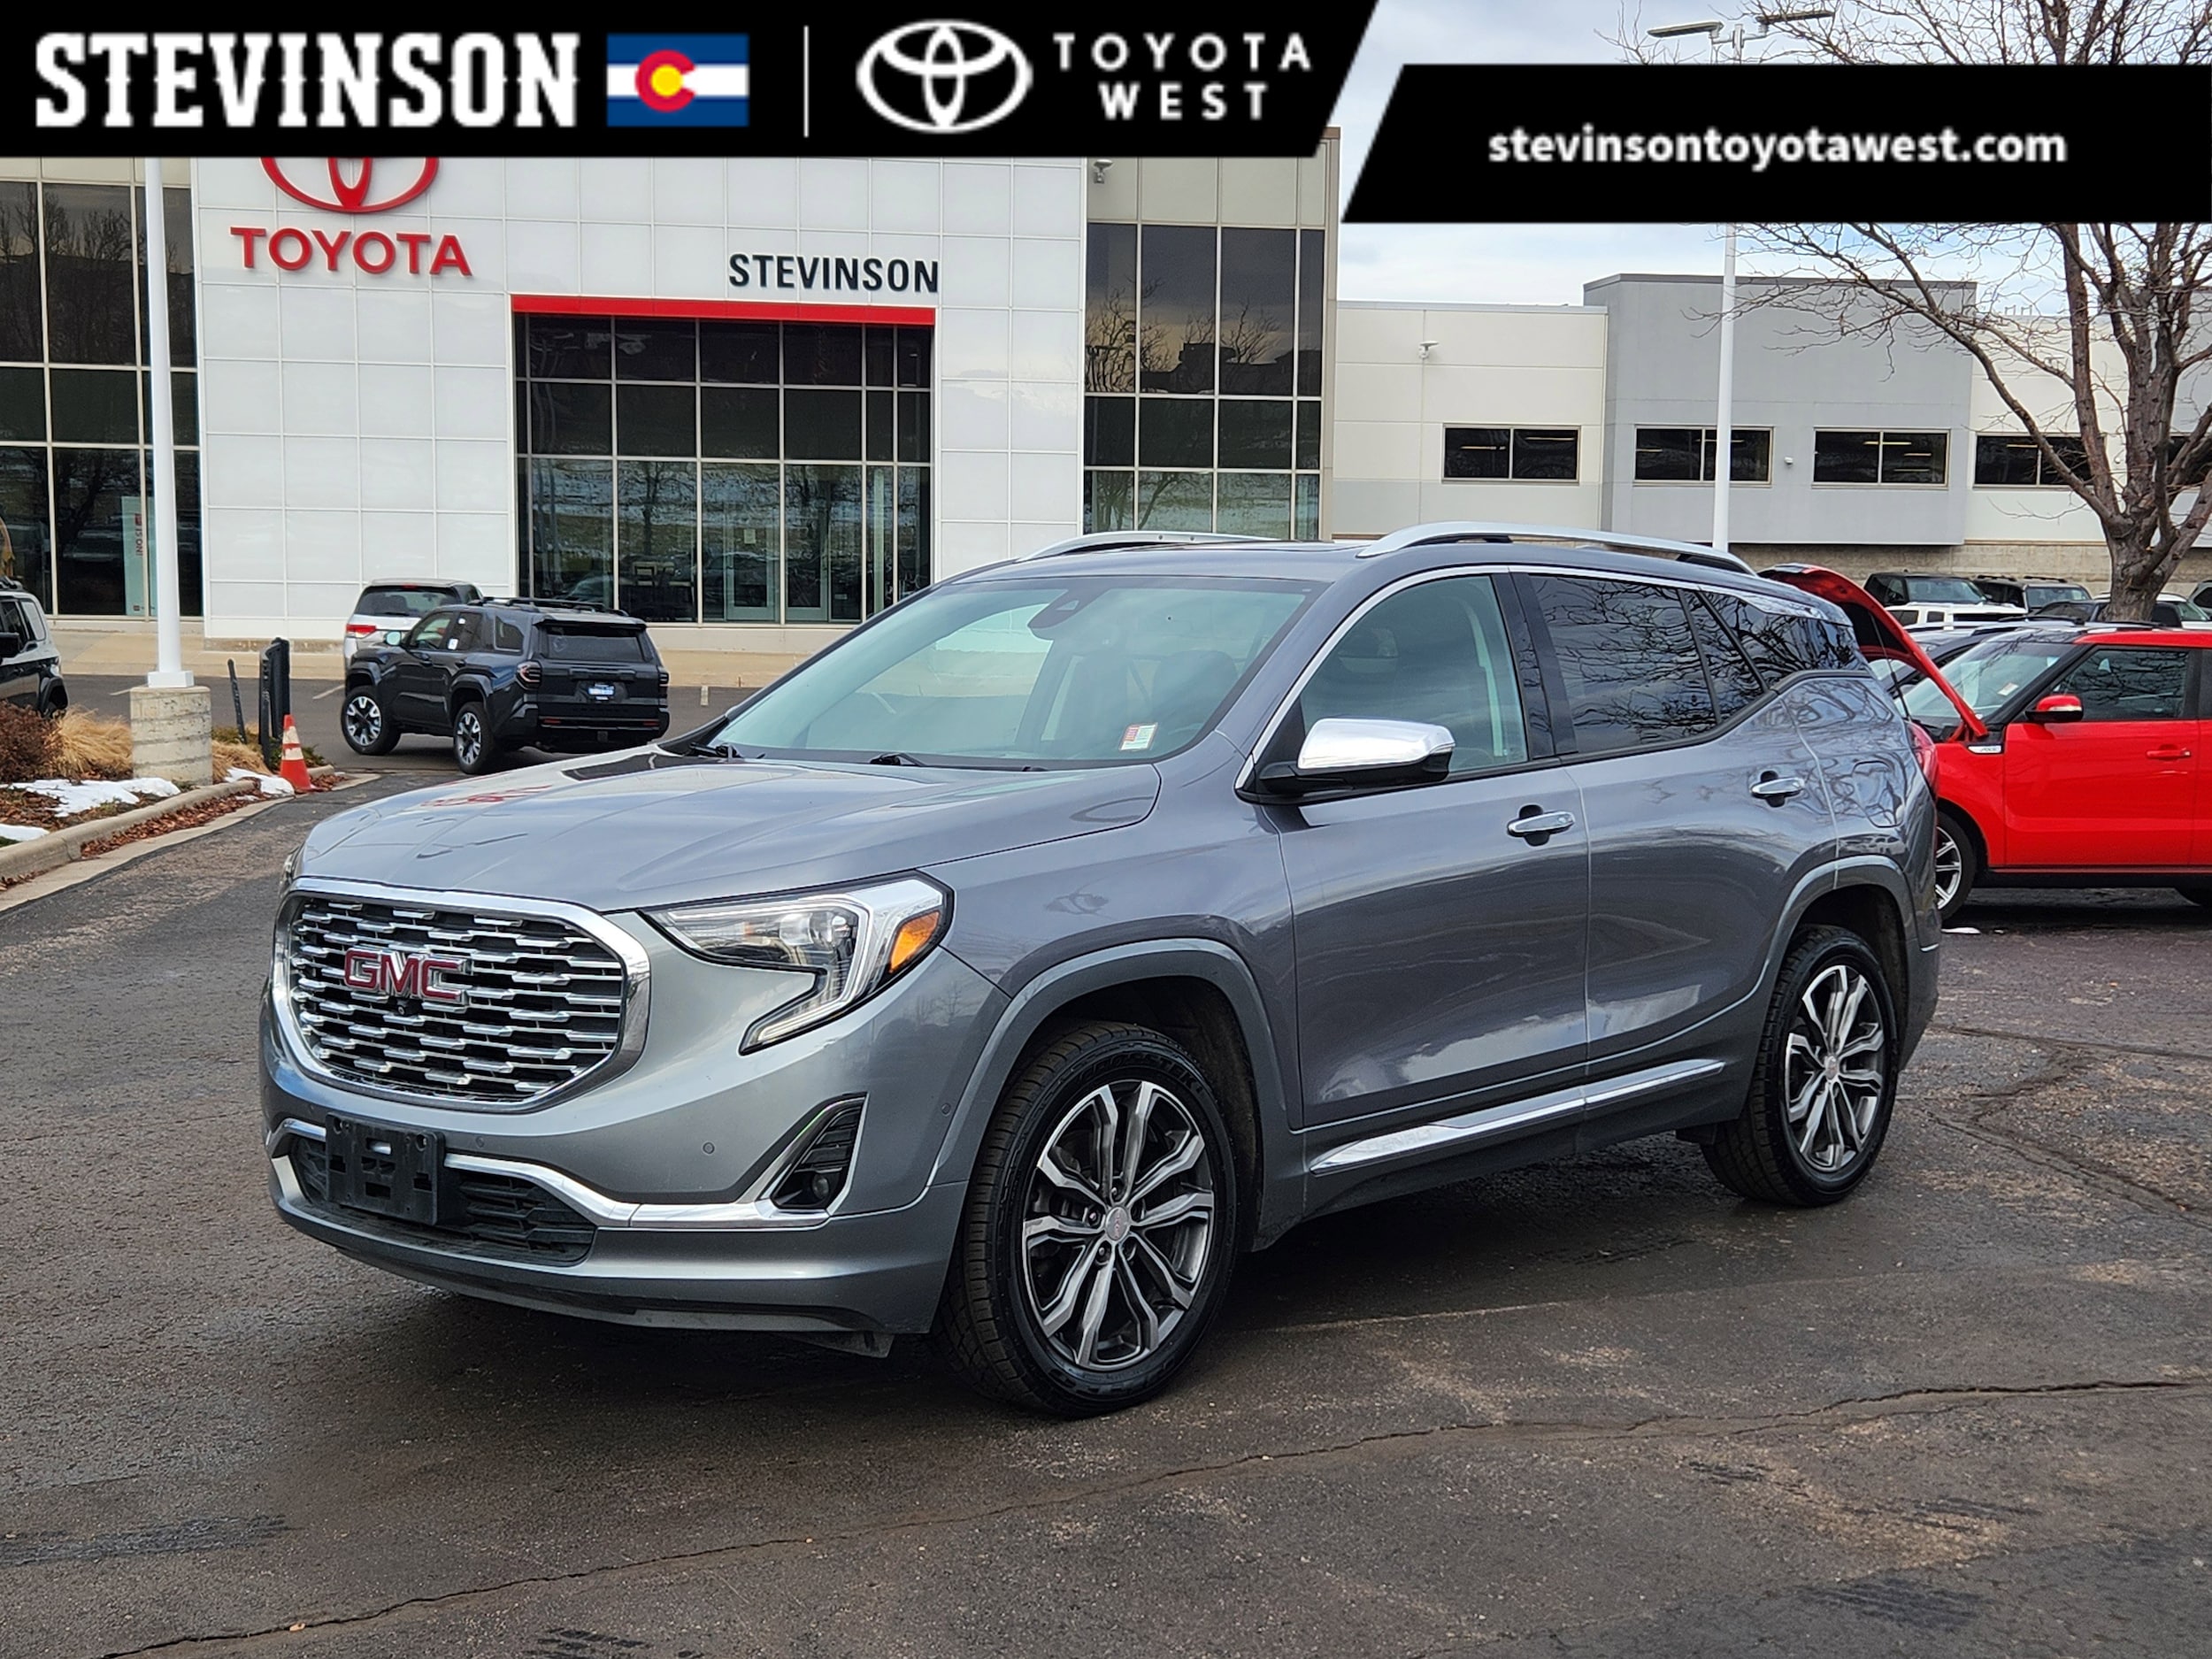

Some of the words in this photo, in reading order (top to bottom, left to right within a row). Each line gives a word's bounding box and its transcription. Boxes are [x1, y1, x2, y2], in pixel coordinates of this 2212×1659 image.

[230, 227, 472, 277] TOYOTA
[729, 253, 939, 293] STEVINSON
[344, 948, 466, 1003] GMC
